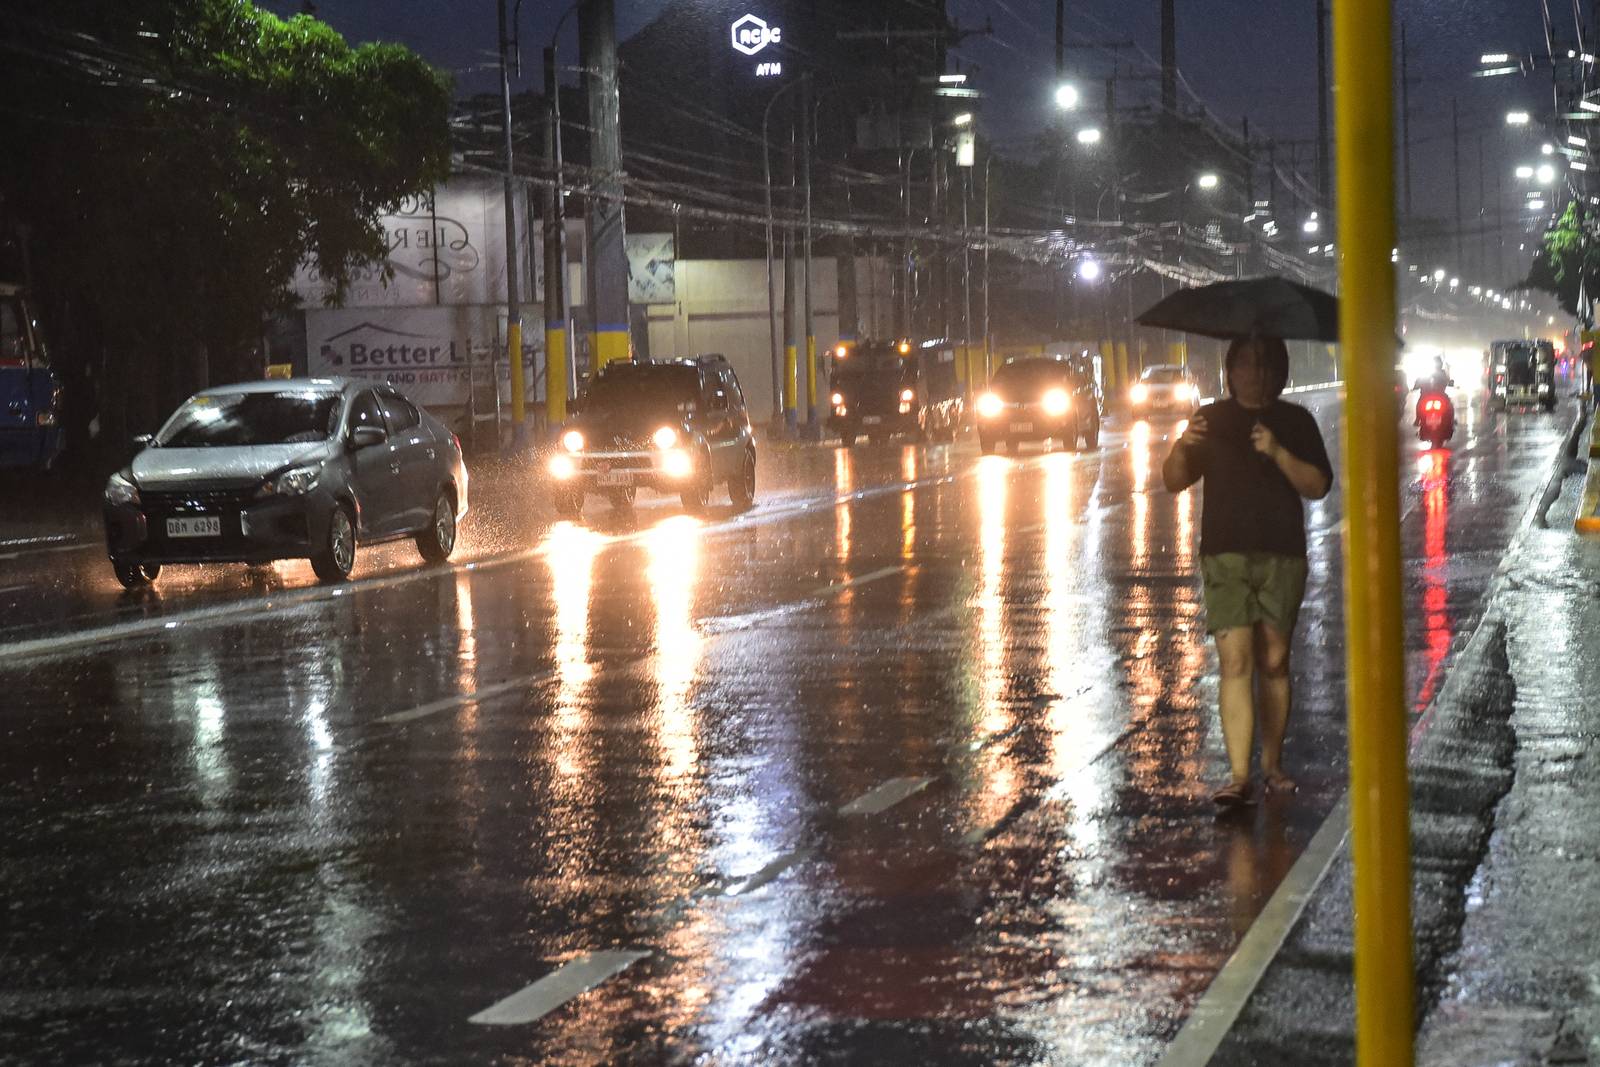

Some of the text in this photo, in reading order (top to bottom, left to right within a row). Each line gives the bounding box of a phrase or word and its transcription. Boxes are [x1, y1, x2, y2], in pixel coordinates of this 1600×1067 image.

[756, 63, 781, 76] ATM
[350, 343, 440, 365] Better
[387, 372, 415, 385] AND
